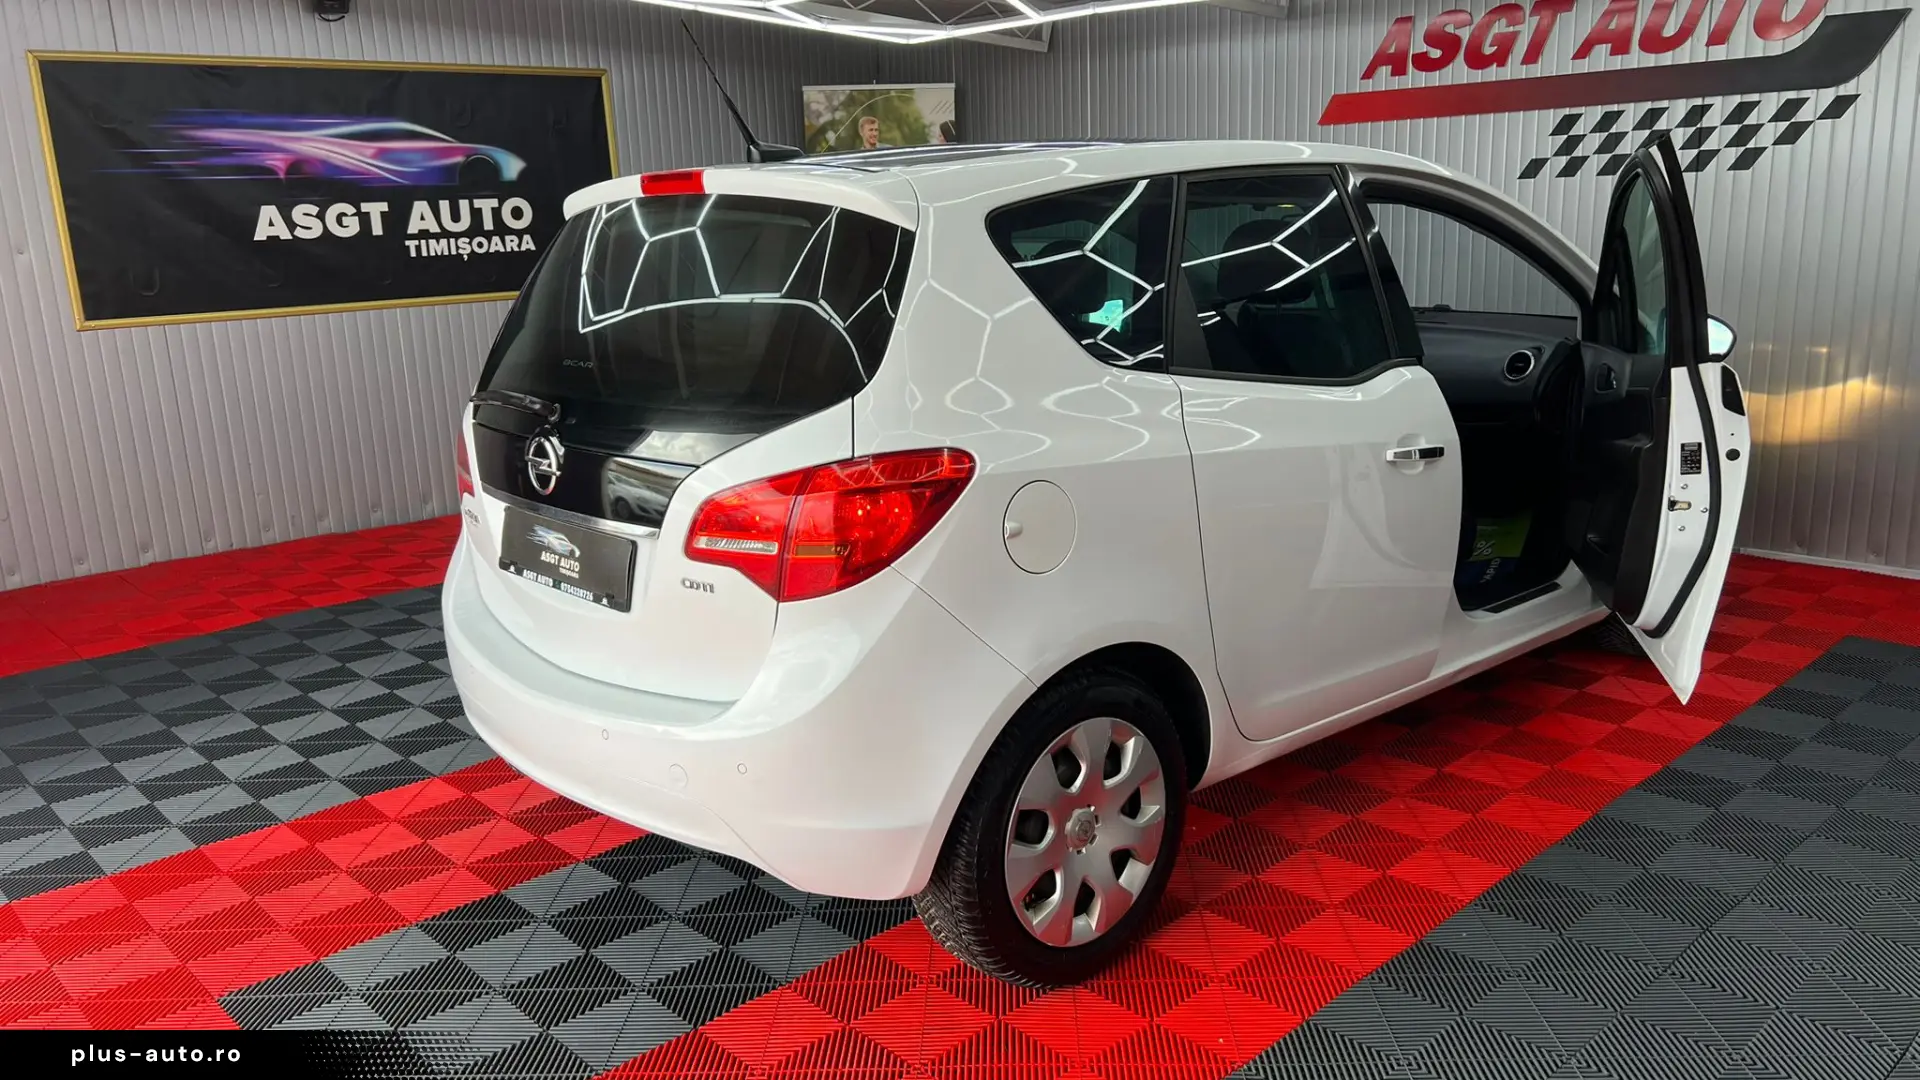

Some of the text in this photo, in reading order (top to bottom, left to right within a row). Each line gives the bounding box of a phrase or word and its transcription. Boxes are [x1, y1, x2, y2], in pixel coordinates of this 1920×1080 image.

[1360, 0, 1828, 80] ASGT AUTO
[253, 197, 533, 241] ASGT AUTO
[404, 234, 536, 261] TIMIȘOARA
[540, 551, 580, 572] ASGT AUTO
[522, 569, 538, 582] ASGT
[537, 575, 553, 587] AUTO
